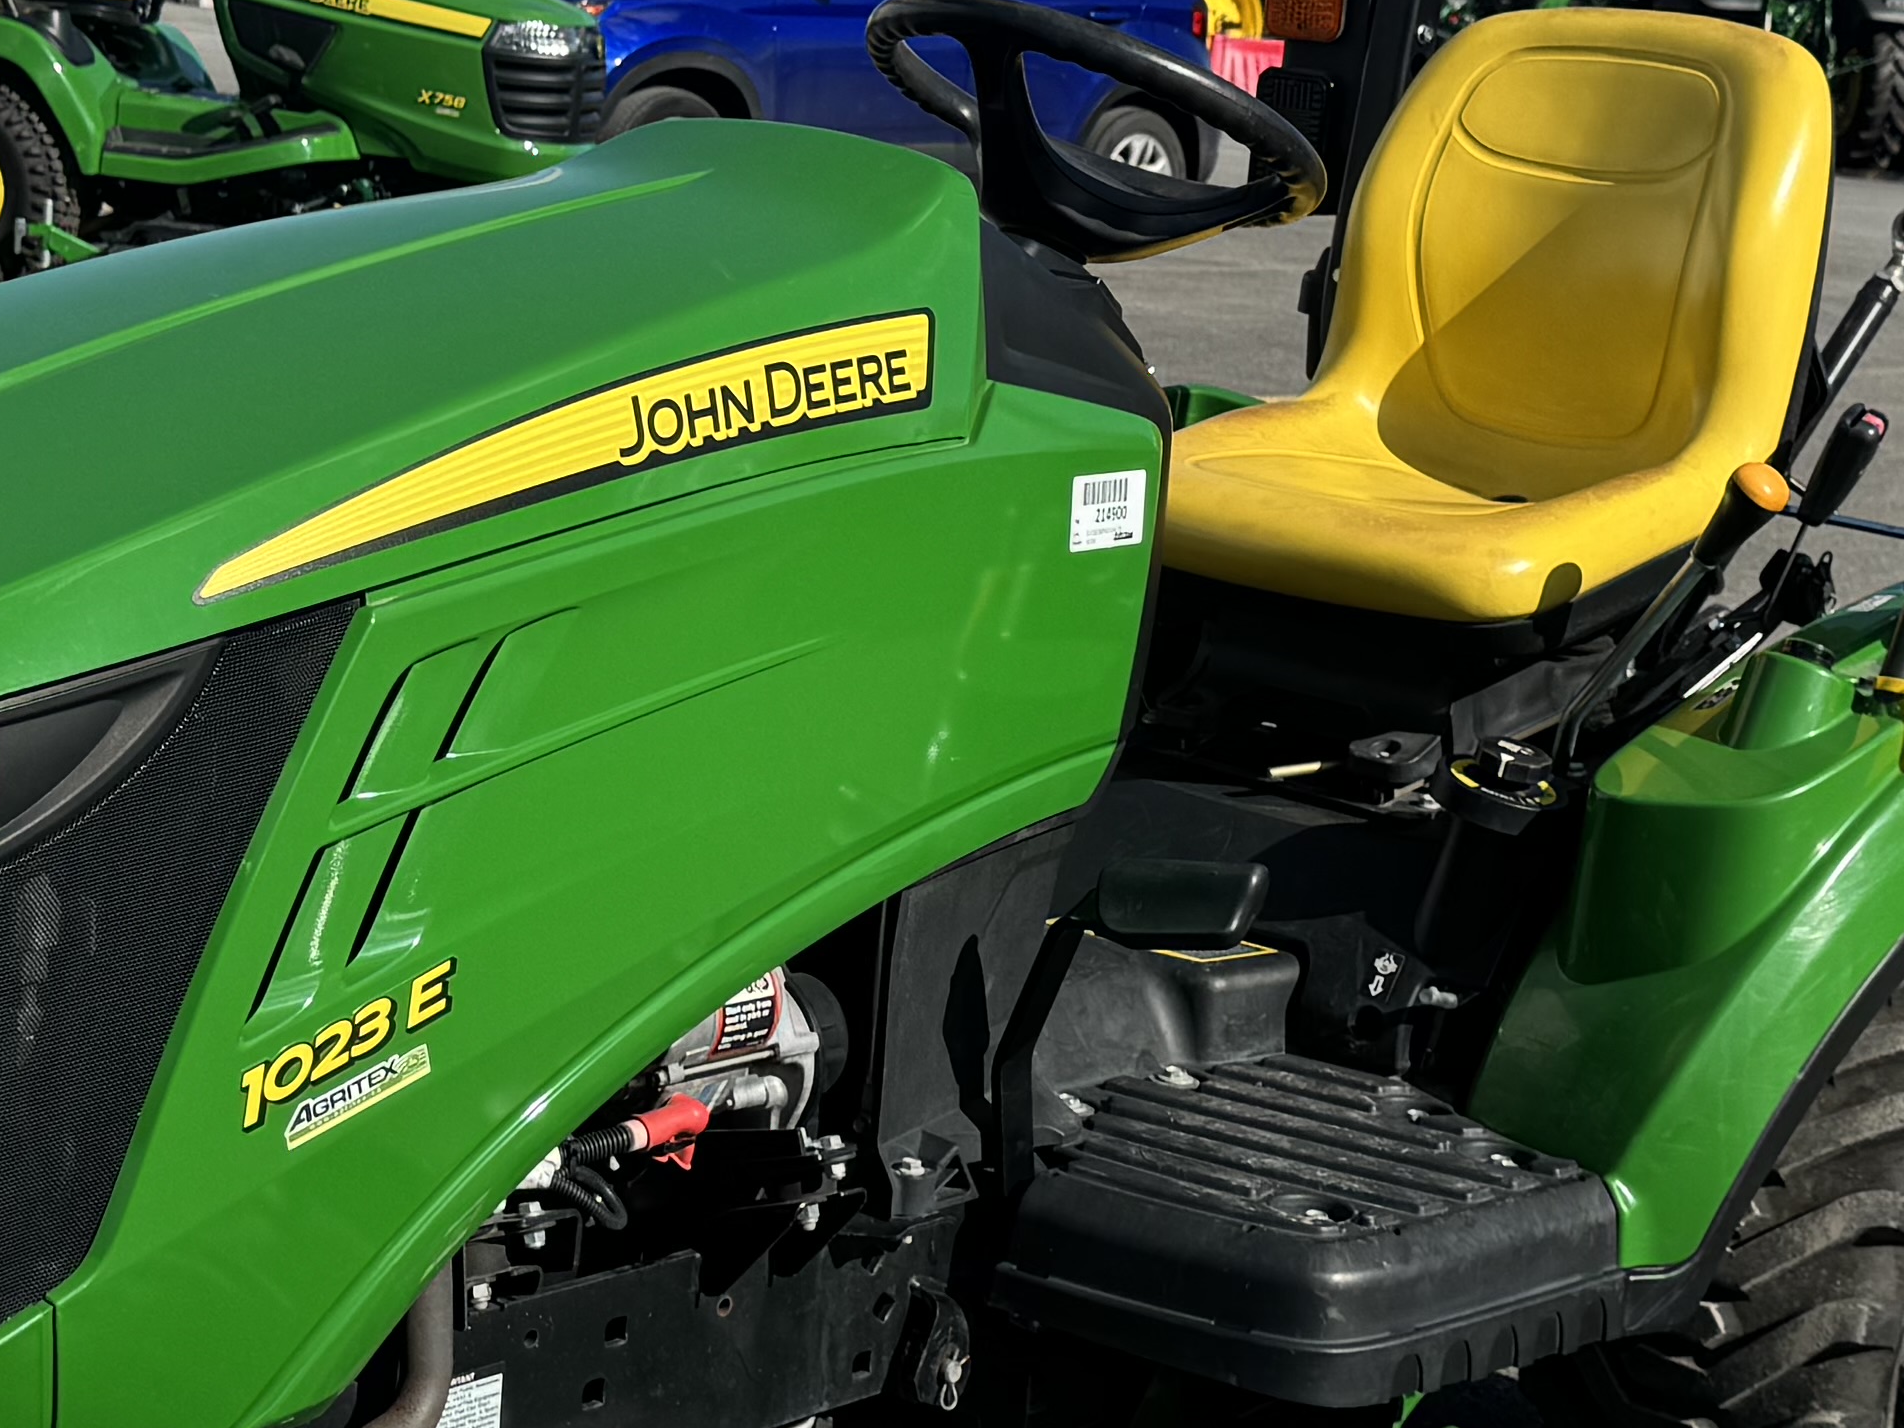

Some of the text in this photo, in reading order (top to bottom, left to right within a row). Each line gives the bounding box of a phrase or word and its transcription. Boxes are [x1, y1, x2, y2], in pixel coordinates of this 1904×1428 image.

[618, 348, 912, 458] JOHN DEERE
[241, 995, 396, 1132] 1023
[407, 958, 457, 1032] E
[288, 1057, 399, 1133] AGRITEX
